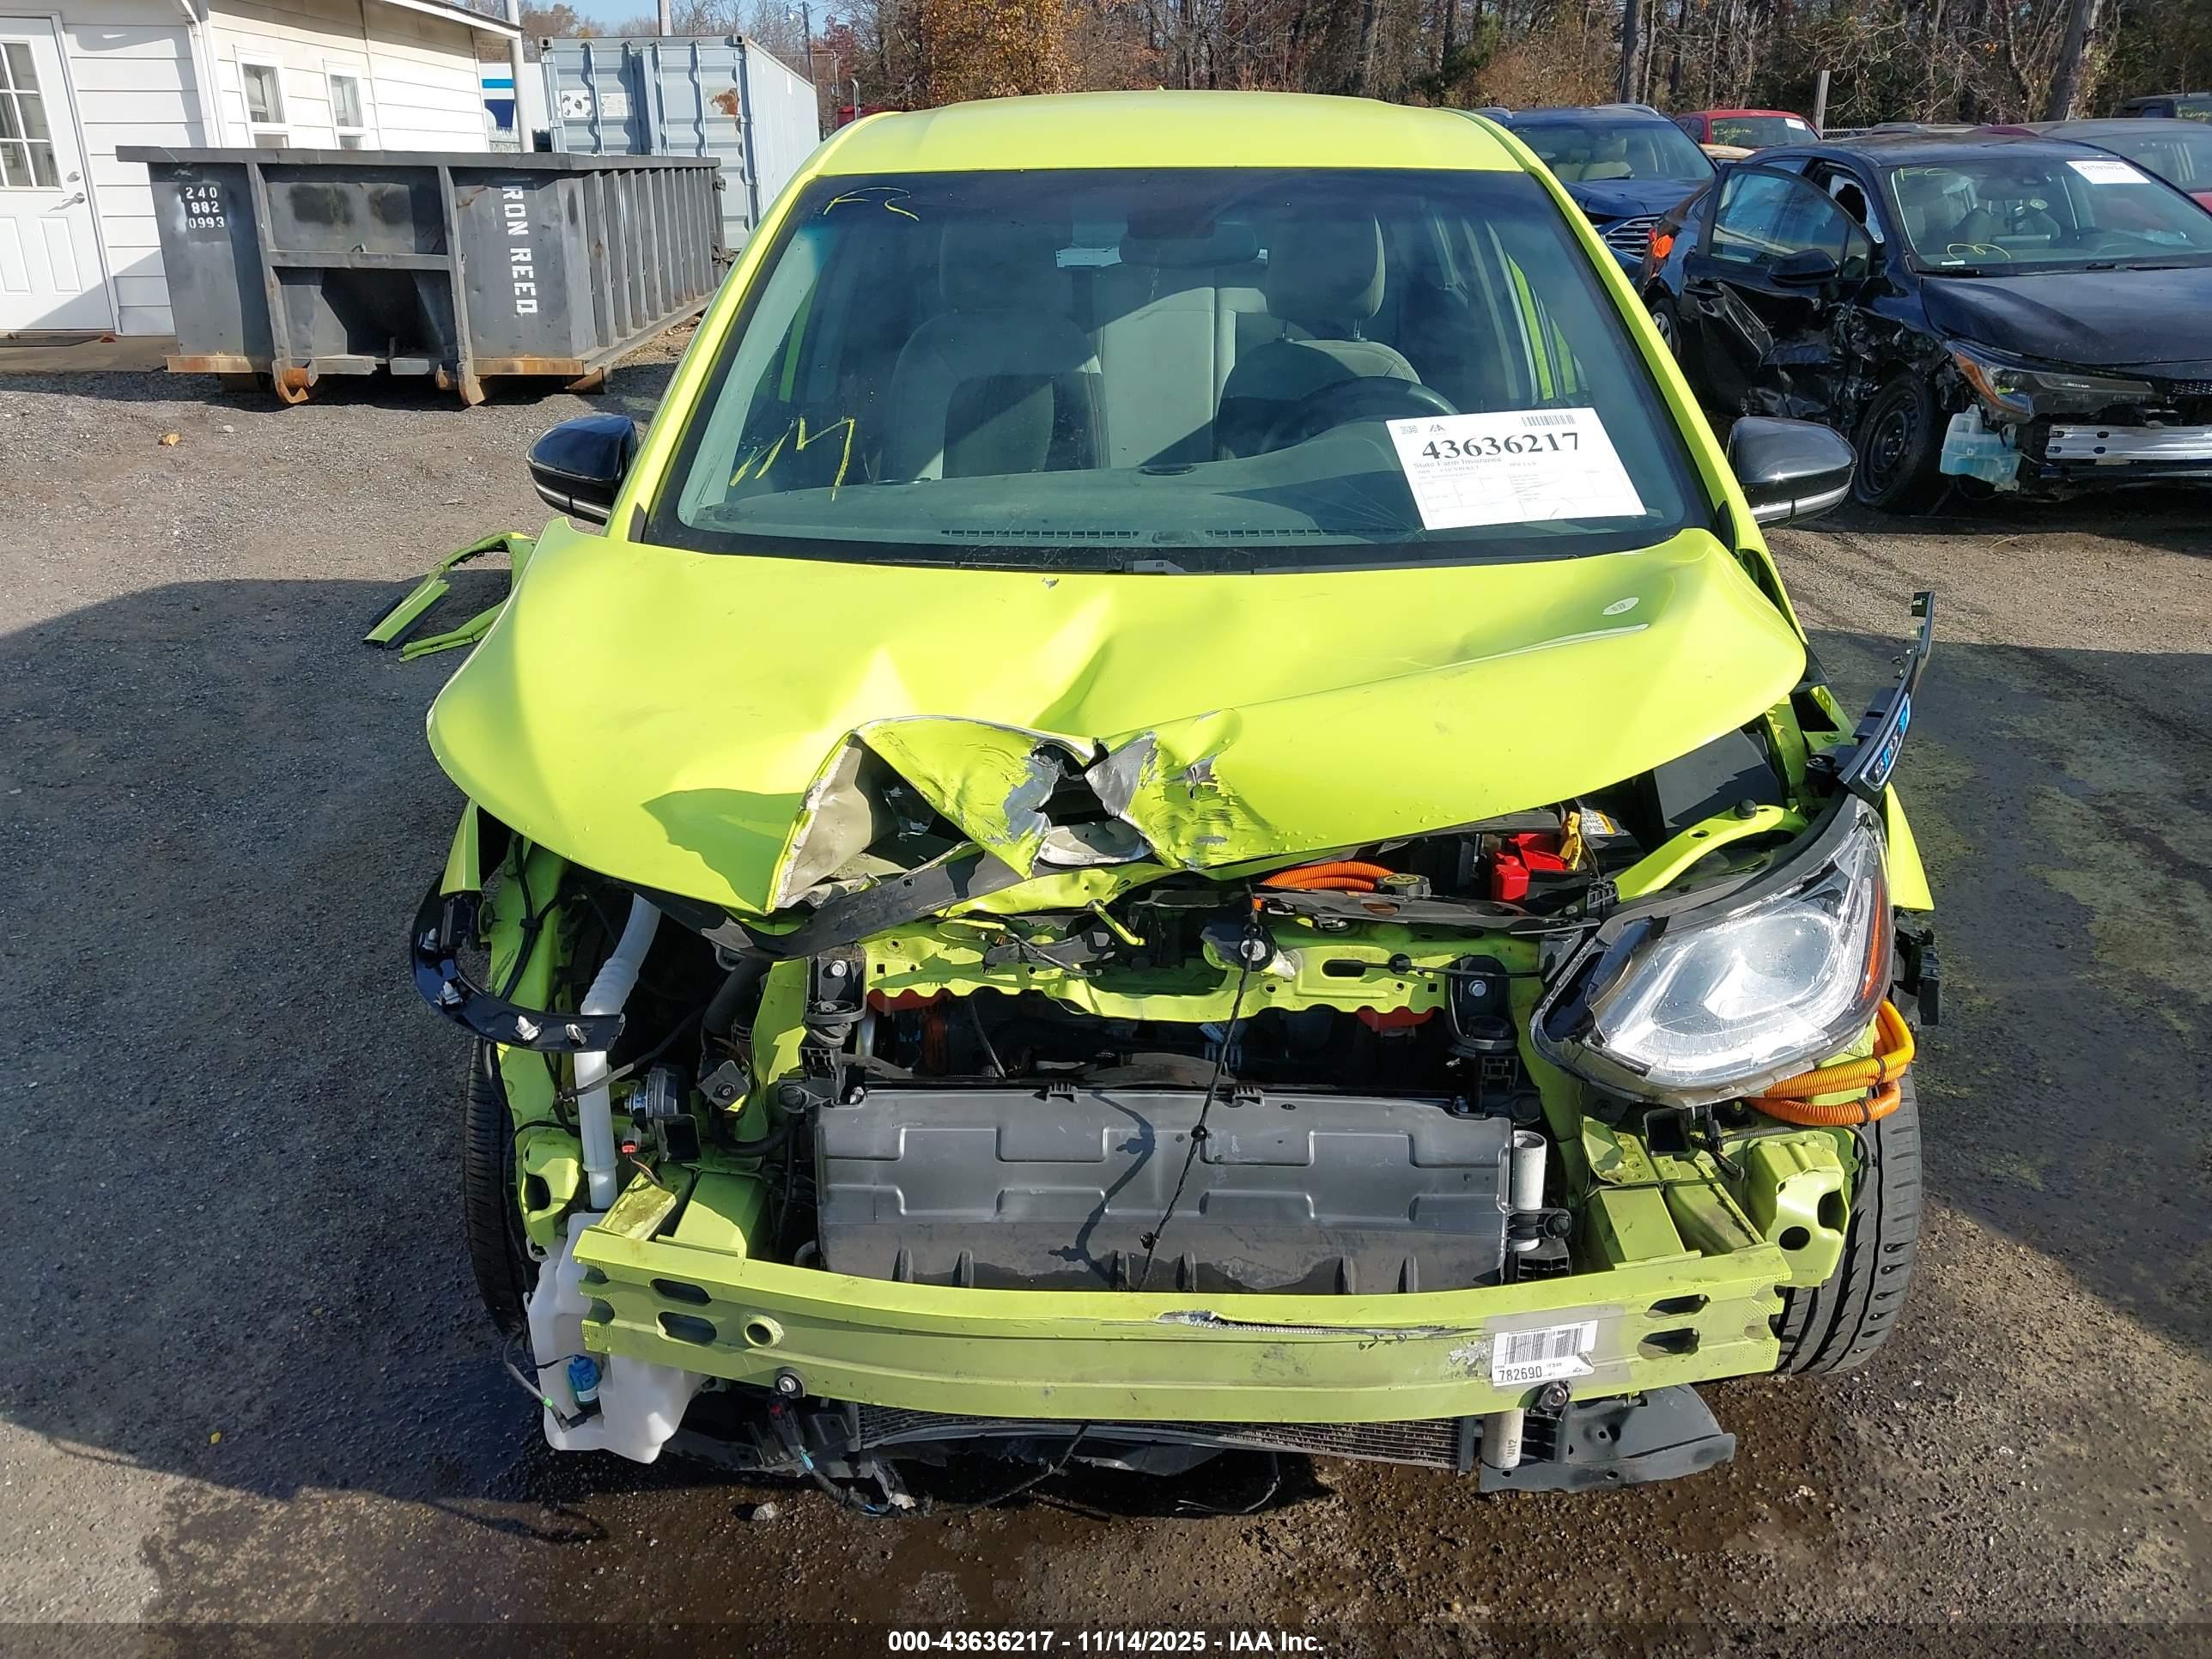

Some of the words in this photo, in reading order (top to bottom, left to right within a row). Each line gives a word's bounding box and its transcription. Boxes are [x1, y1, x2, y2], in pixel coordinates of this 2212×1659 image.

[185, 186, 218, 199] 240
[191, 201, 220, 214] 882
[501, 185, 529, 235] RON
[189, 216, 225, 229] 0993
[510, 248, 538, 314] REED
[1422, 432, 1579, 459] 43636217
[1498, 1365, 1542, 1382] 782690
